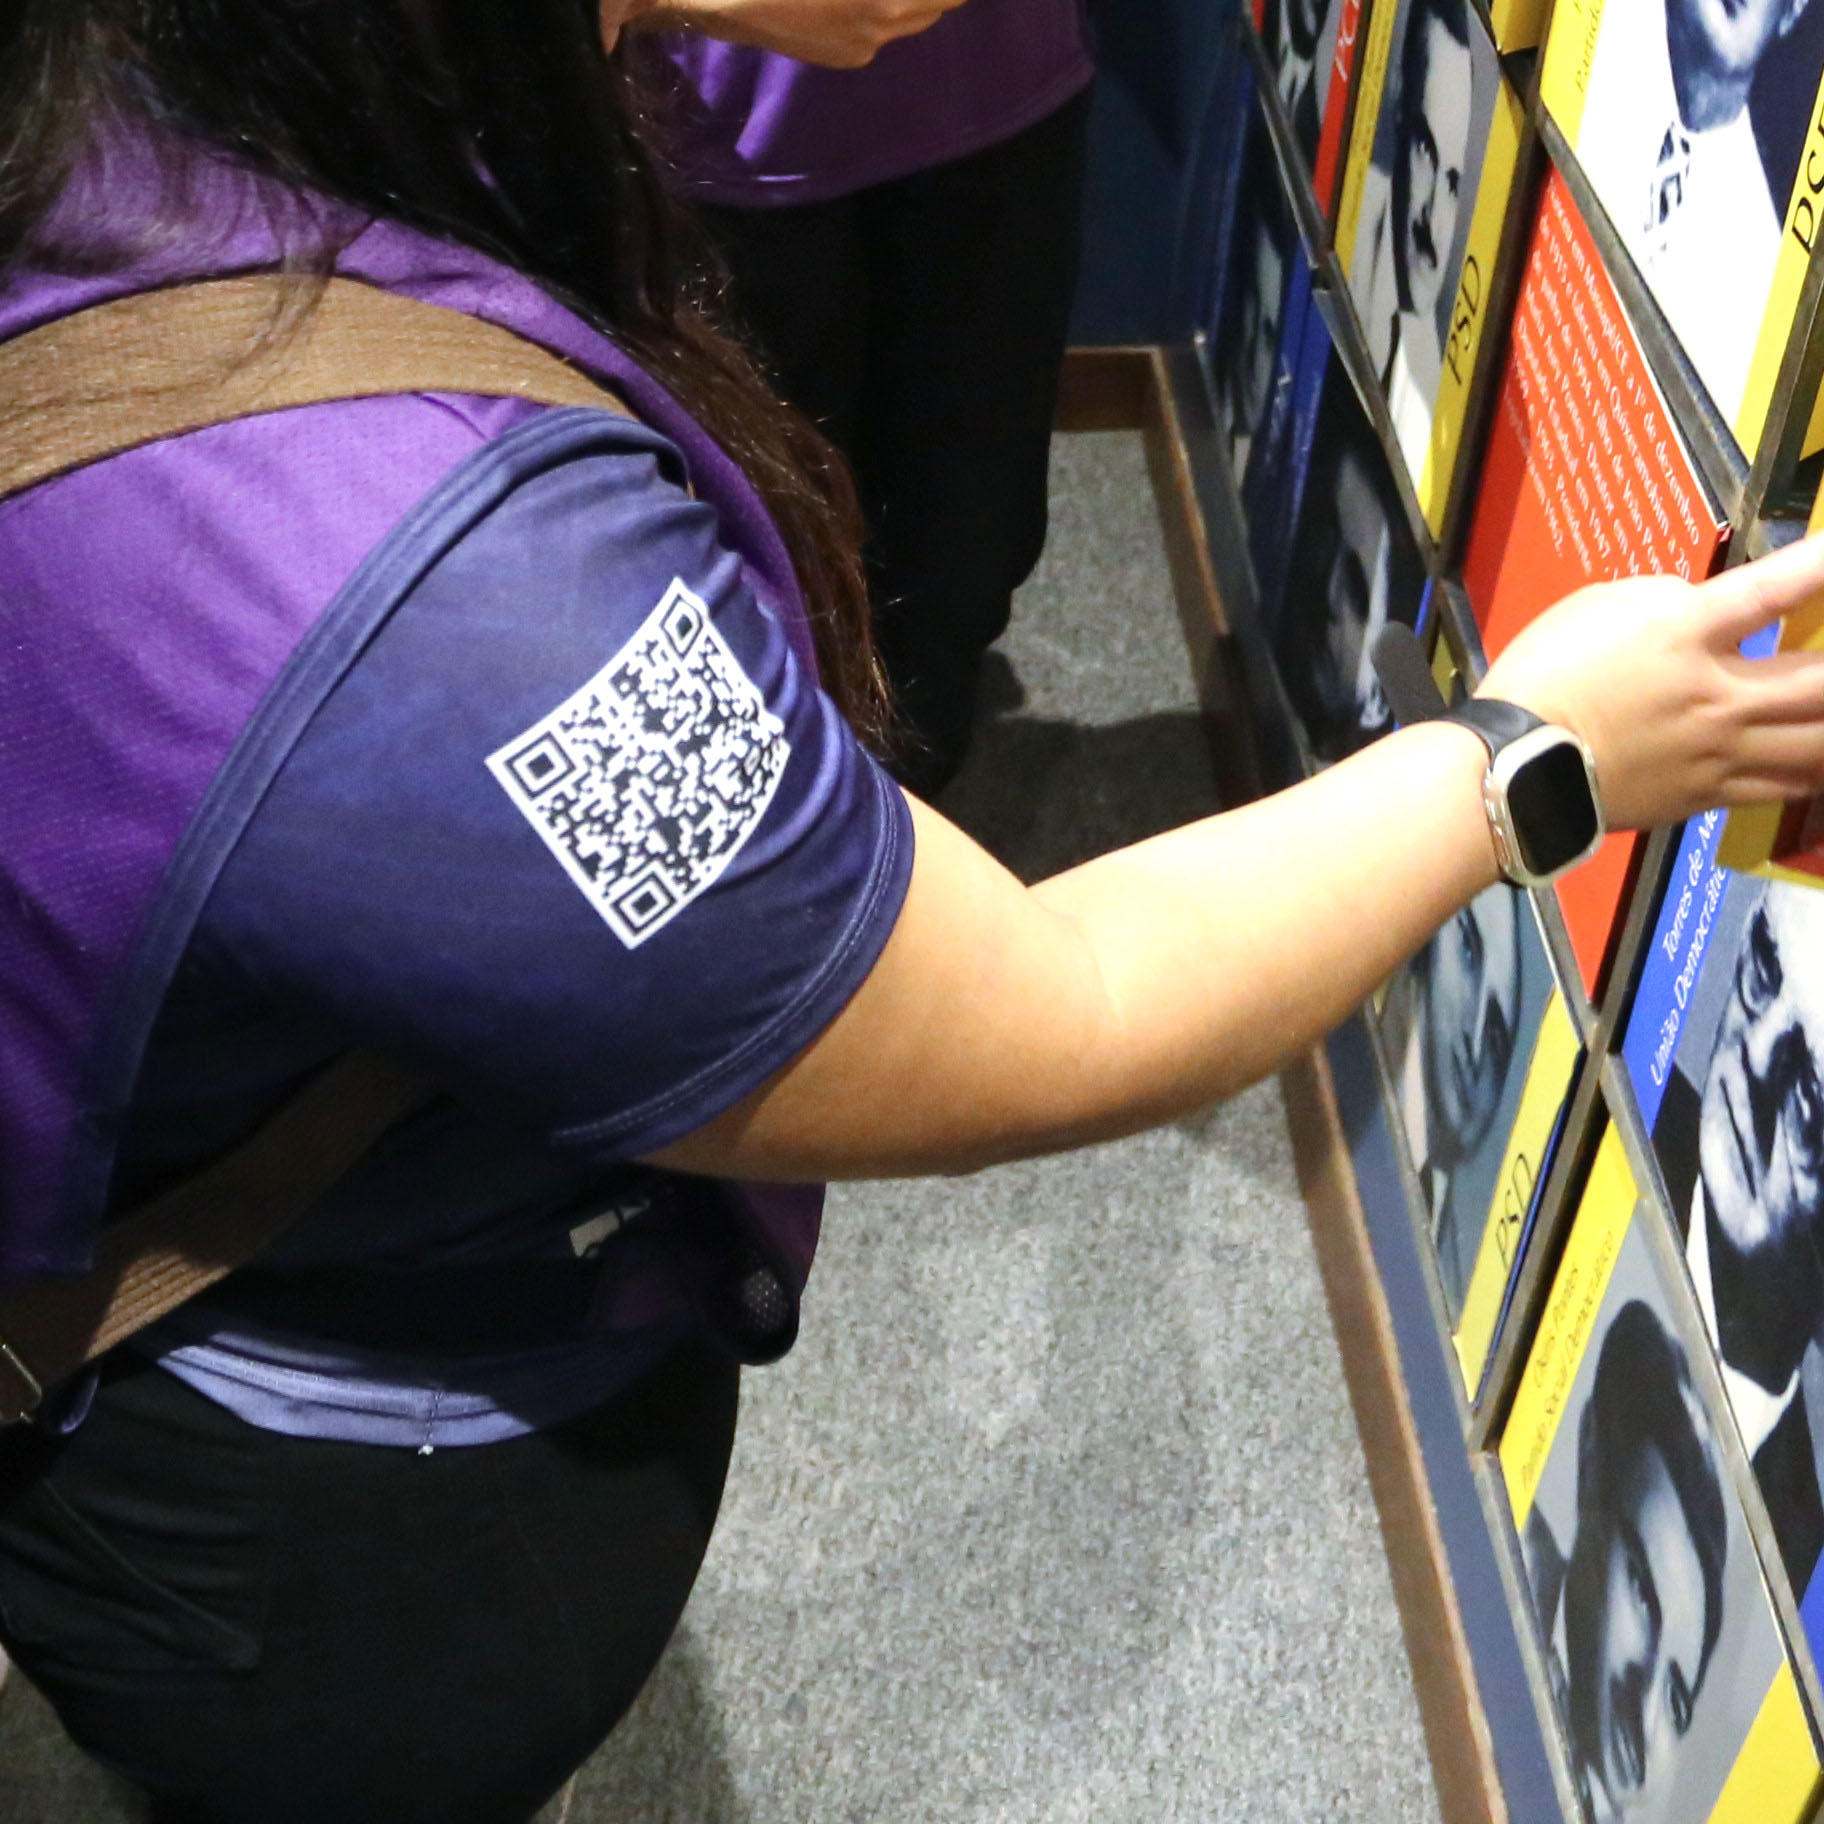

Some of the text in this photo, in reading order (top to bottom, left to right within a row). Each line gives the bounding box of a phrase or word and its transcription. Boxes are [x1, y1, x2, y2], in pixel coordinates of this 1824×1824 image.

[1449, 252, 1482, 387] PSD
[1560, 314, 1572, 360] de
[1592, 393, 1613, 463] Filho
[1611, 442, 1625, 491] de
[1623, 472, 1643, 538] João
[1571, 231, 1585, 277] em
[1583, 261, 1627, 378] Massapê/CE
[1626, 363, 1634, 395] a
[1643, 404, 1656, 448] de
[1655, 432, 1700, 551] dezembro
[1575, 464, 1589, 518] em
[1586, 436, 1615, 524] Doutor
[1613, 506, 1628, 559] em
[1596, 347, 1612, 400] em
[1609, 378, 1669, 542] Quixeramobim
[1668, 523, 1677, 559] a
[1675, 540, 1690, 592] 20
[1662, 883, 1692, 963] Torres
[1687, 848, 1704, 887] de
[1651, 1008, 1680, 1088] União
